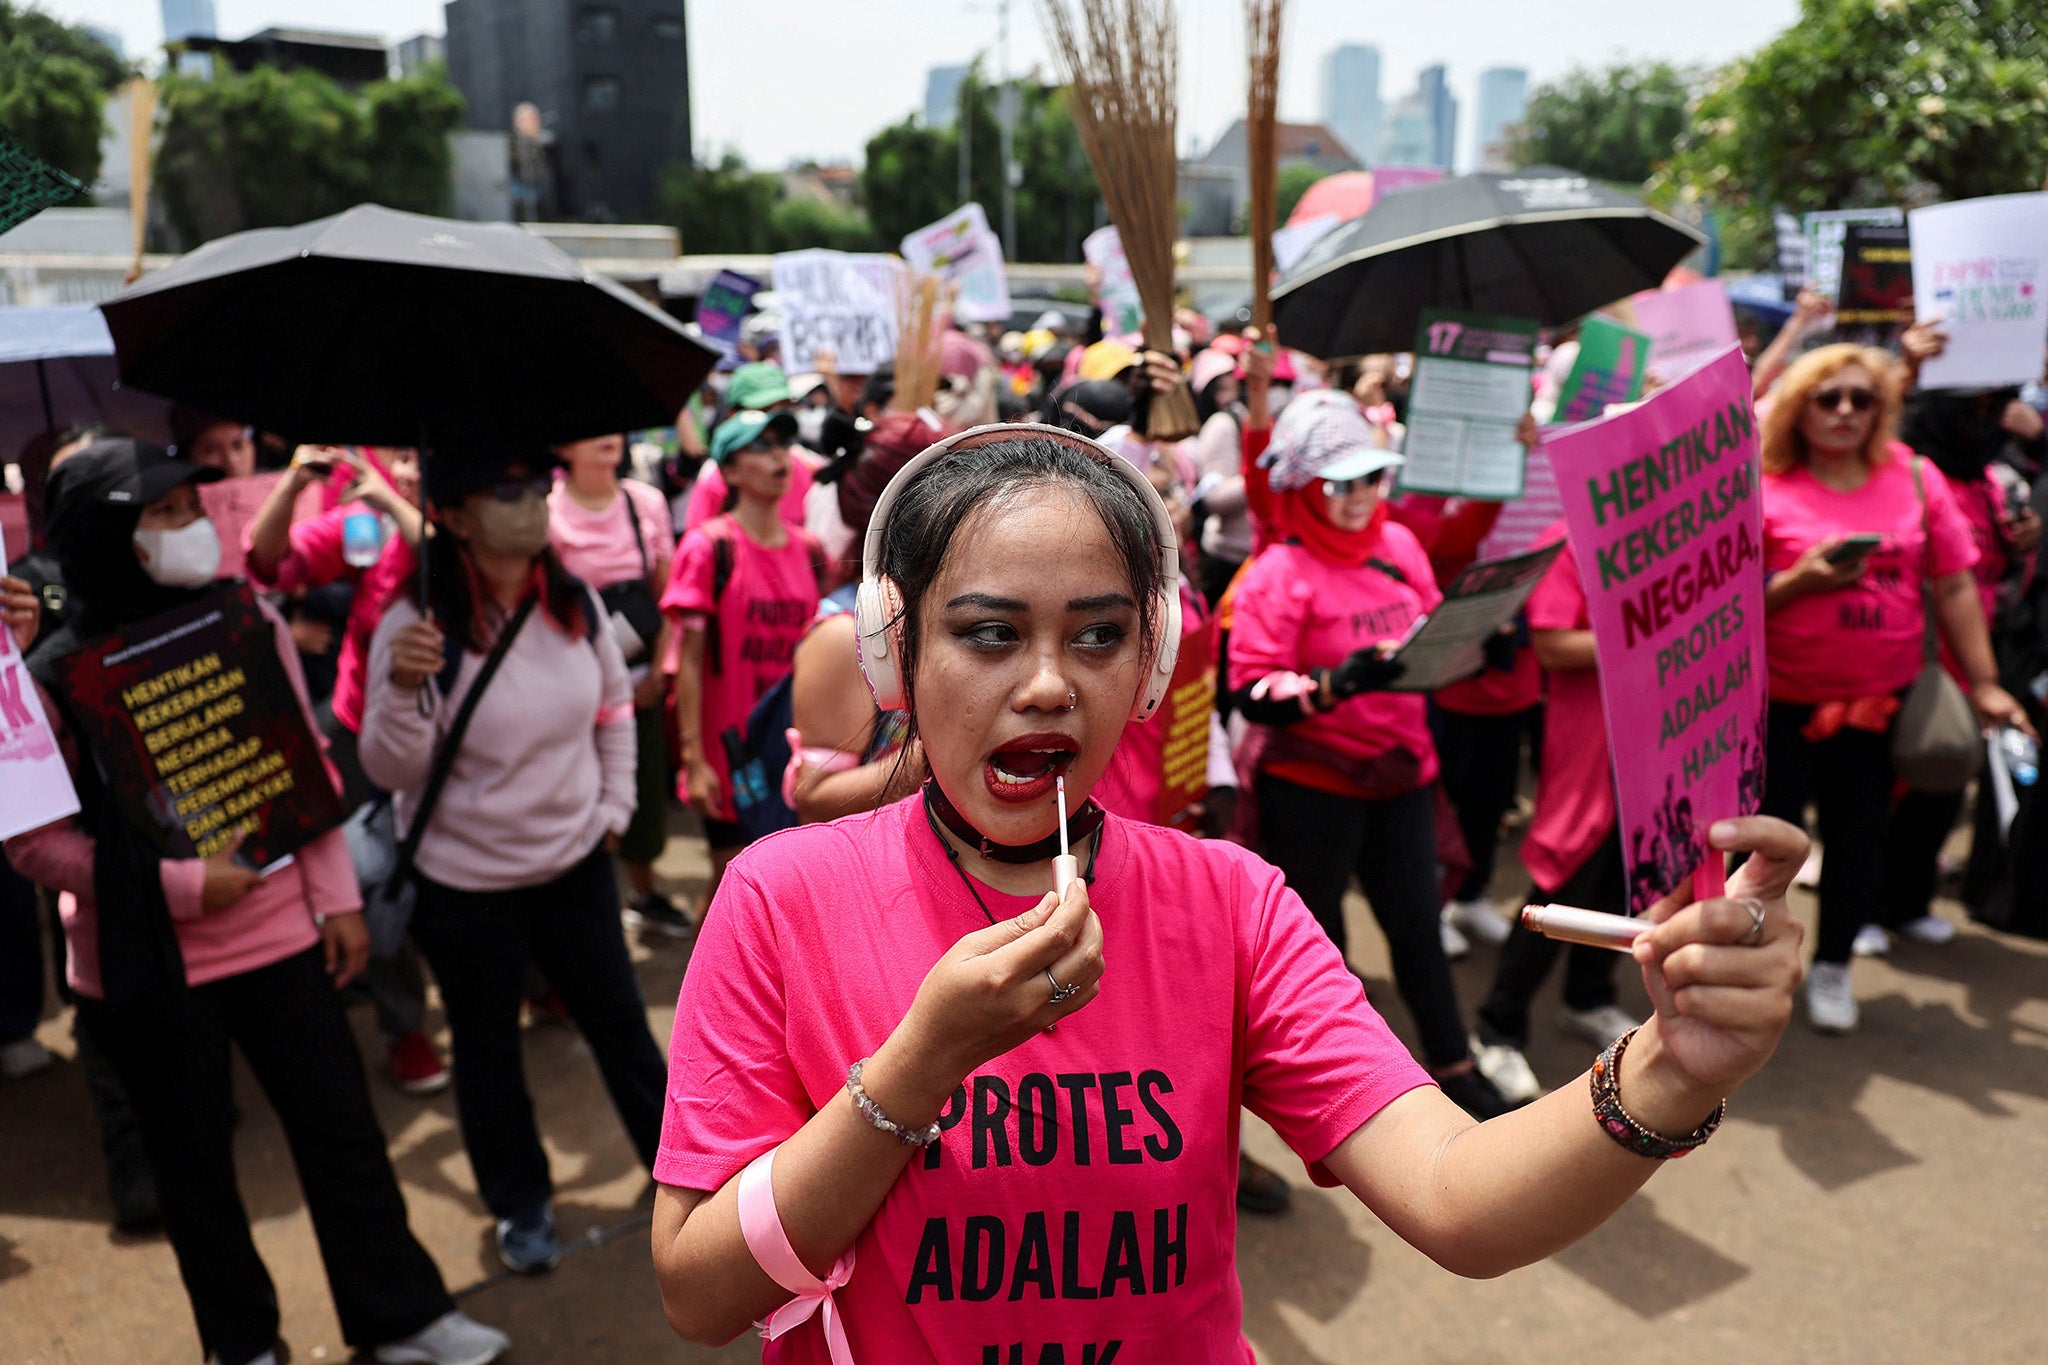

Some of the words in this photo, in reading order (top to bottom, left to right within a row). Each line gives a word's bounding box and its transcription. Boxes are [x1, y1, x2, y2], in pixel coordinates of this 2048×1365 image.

[1428, 321, 1462, 355] 17
[1587, 396, 1752, 526] HENTIKAN
[1621, 521, 1759, 650] NEGARA,
[1656, 593, 1744, 688] PROTES
[122, 650, 222, 710] HENTIKAN
[133, 667, 247, 732] KEKERASAN
[1659, 647, 1751, 749] ADALAH
[144, 693, 245, 754] BERULANG
[155, 725, 234, 777] NEGARA
[1681, 714, 1739, 788] HAK!
[165, 736, 262, 796] TERHADAP
[176, 750, 286, 819] PEREMPUAN
[185, 805, 227, 842] DAN
[225, 768, 294, 819] RAKYAT
[905, 1203, 1188, 1304] ADALAH
